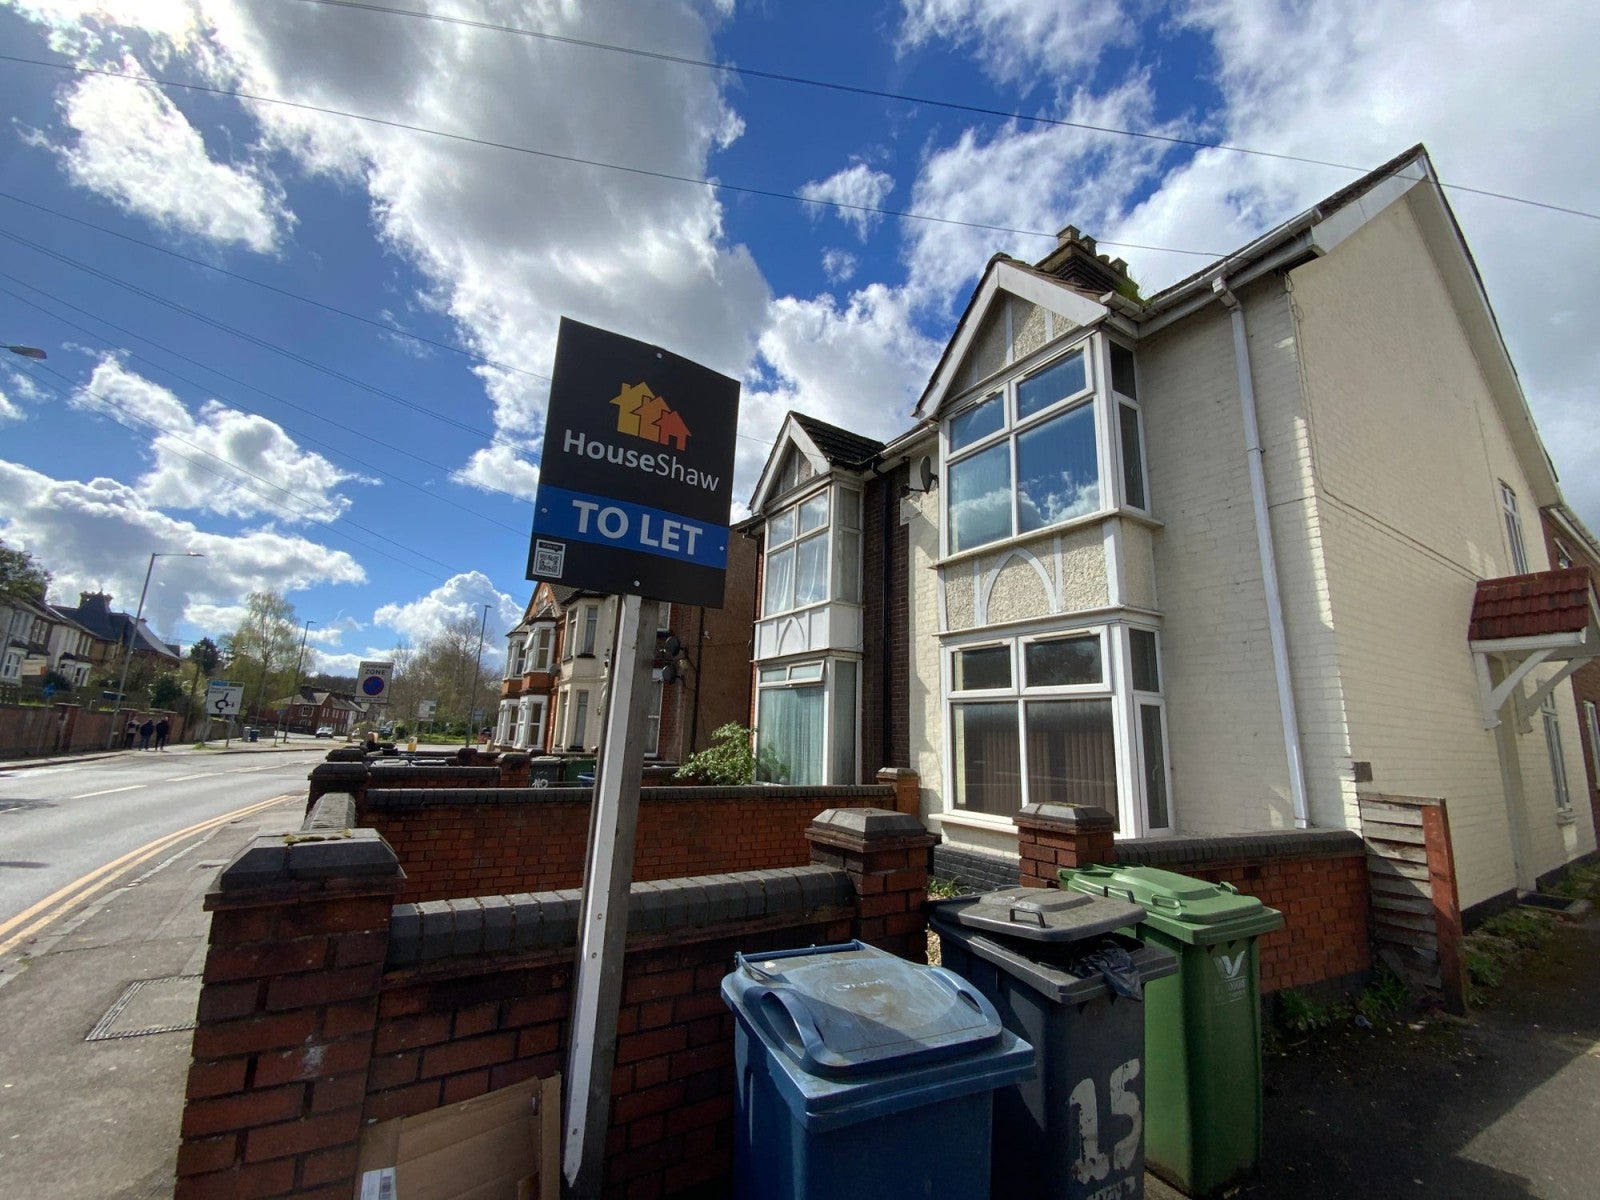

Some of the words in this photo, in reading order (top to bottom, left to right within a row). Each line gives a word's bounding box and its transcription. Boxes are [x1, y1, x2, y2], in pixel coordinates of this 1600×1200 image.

[563, 429, 720, 492] HouseShaw
[573, 499, 630, 539] TO
[640, 513, 703, 555] LET
[1069, 1057, 1142, 1185] 15
